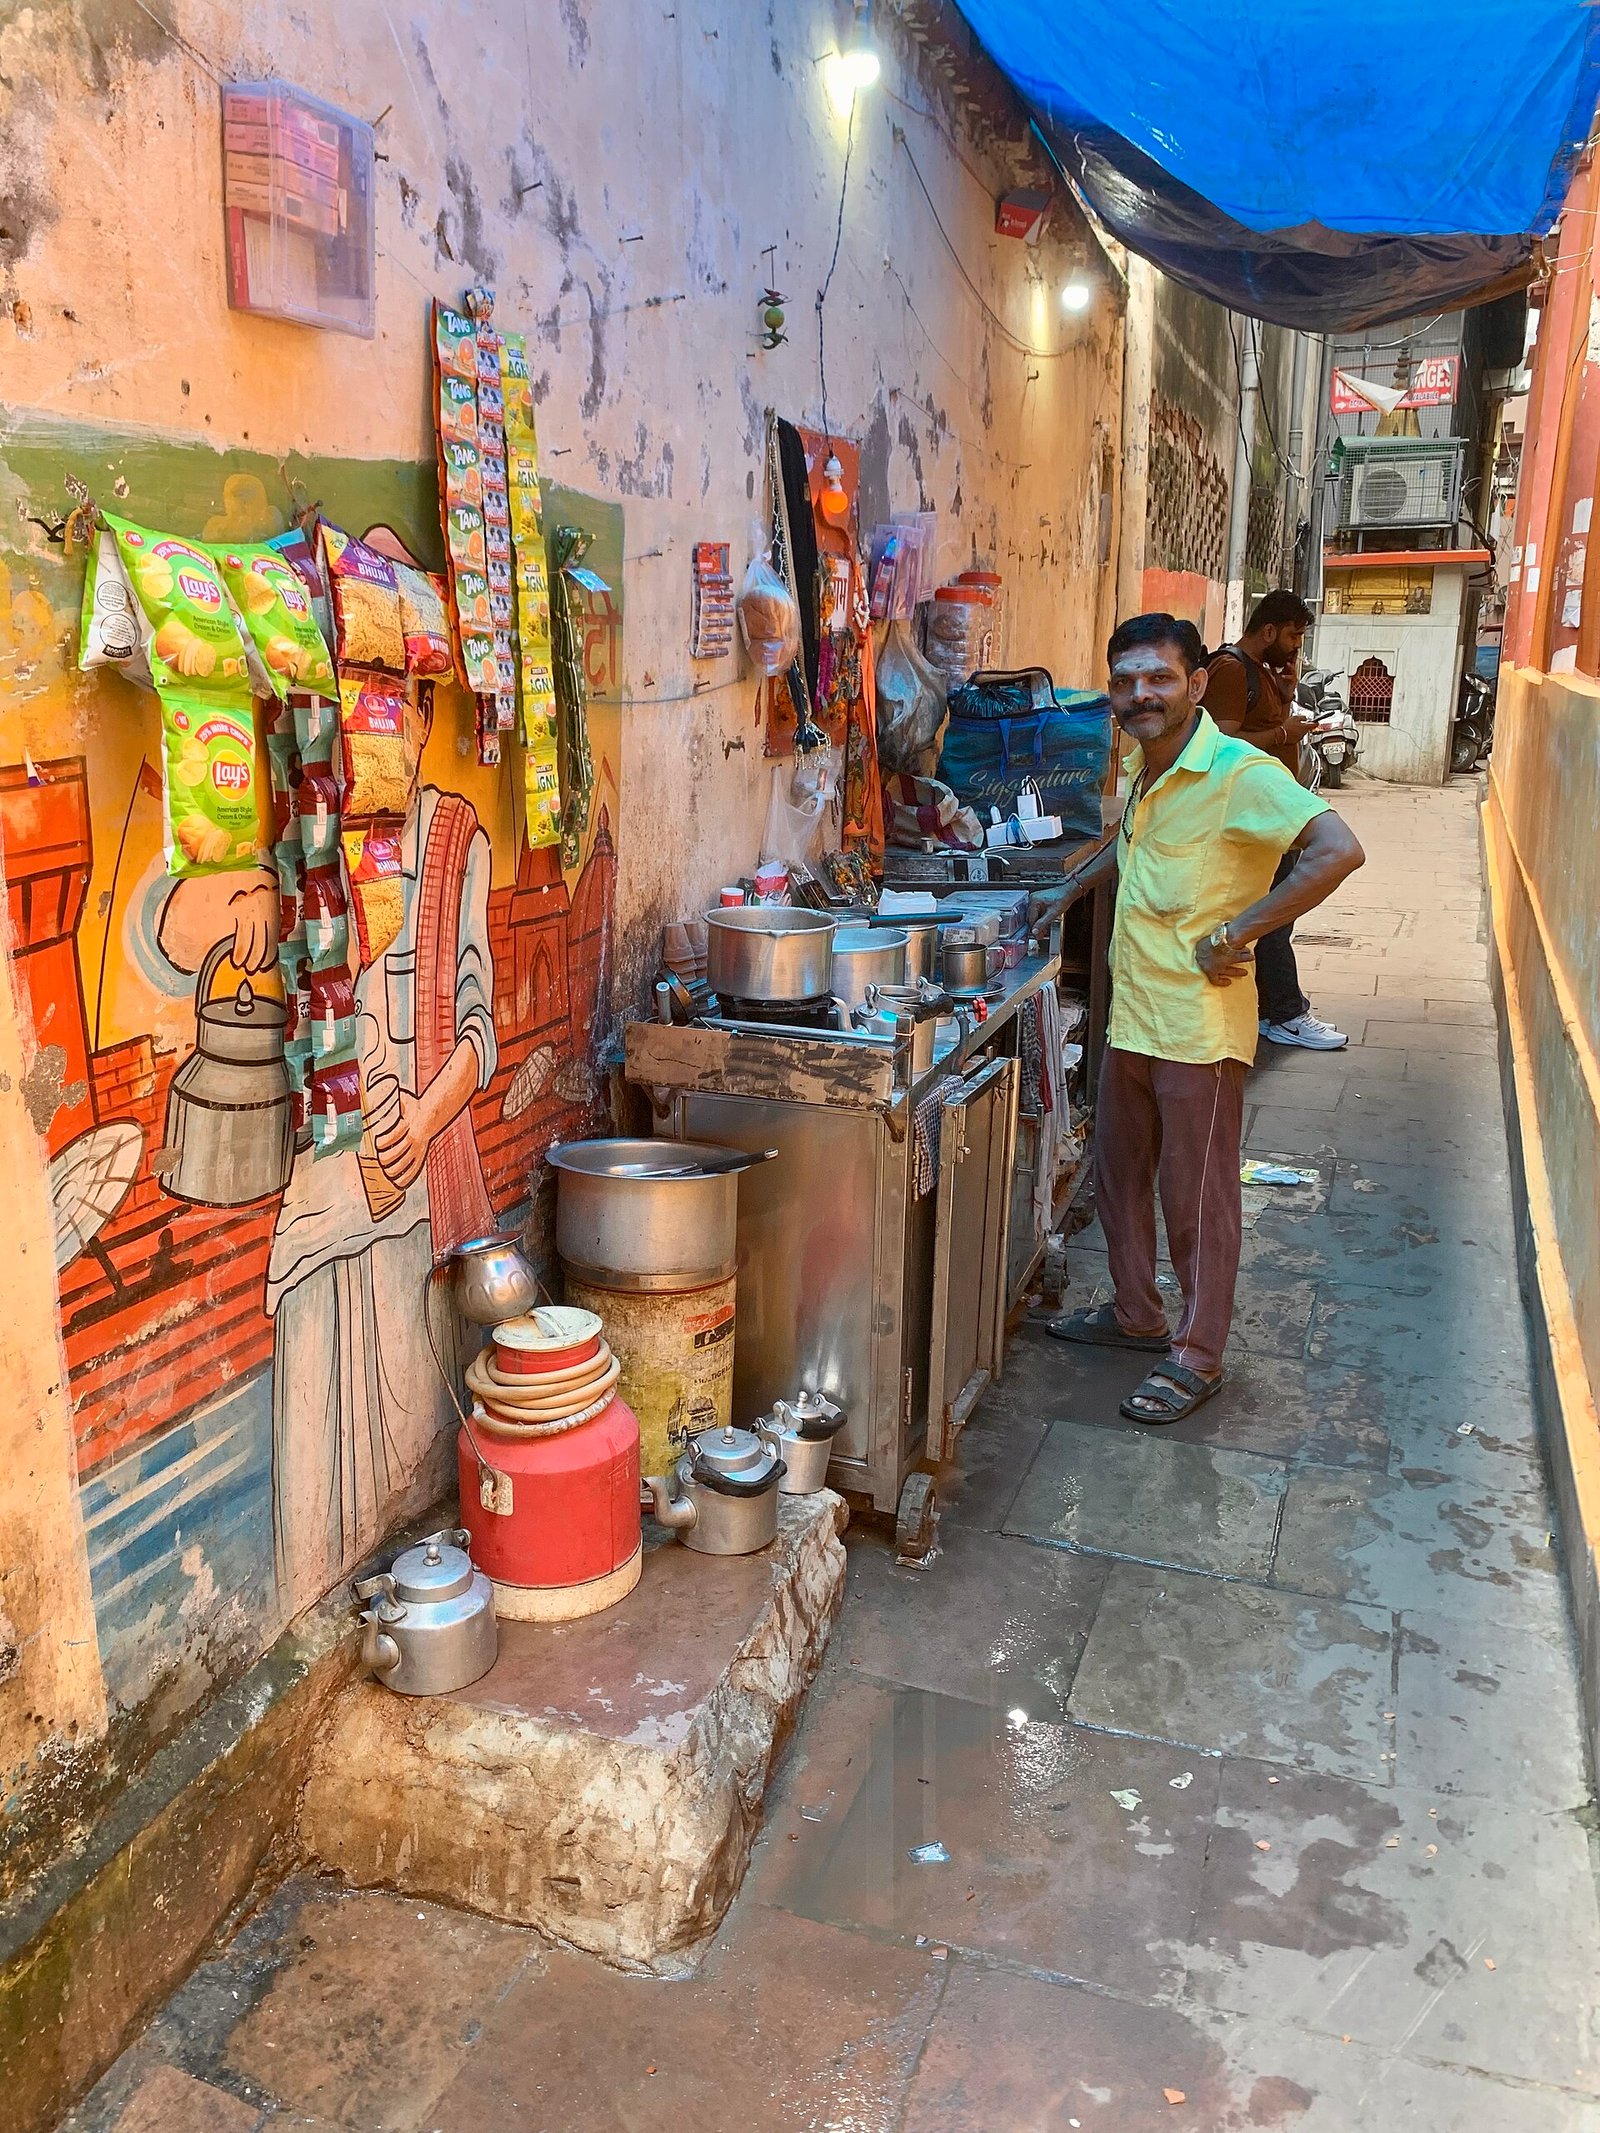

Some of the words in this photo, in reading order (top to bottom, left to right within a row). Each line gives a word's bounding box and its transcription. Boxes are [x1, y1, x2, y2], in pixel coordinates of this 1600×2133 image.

[443, 311, 471, 333] TANG
[447, 378, 471, 399] TANG
[451, 444, 476, 465] TANG
[456, 509, 480, 531] TANG
[358, 563, 390, 583] BHUJIA
[183, 575, 218, 602] Lay's
[462, 574, 485, 596] TANG
[467, 638, 490, 660] TANG
[368, 716, 397, 731] BHUJIA
[215, 761, 248, 789] Lay's
